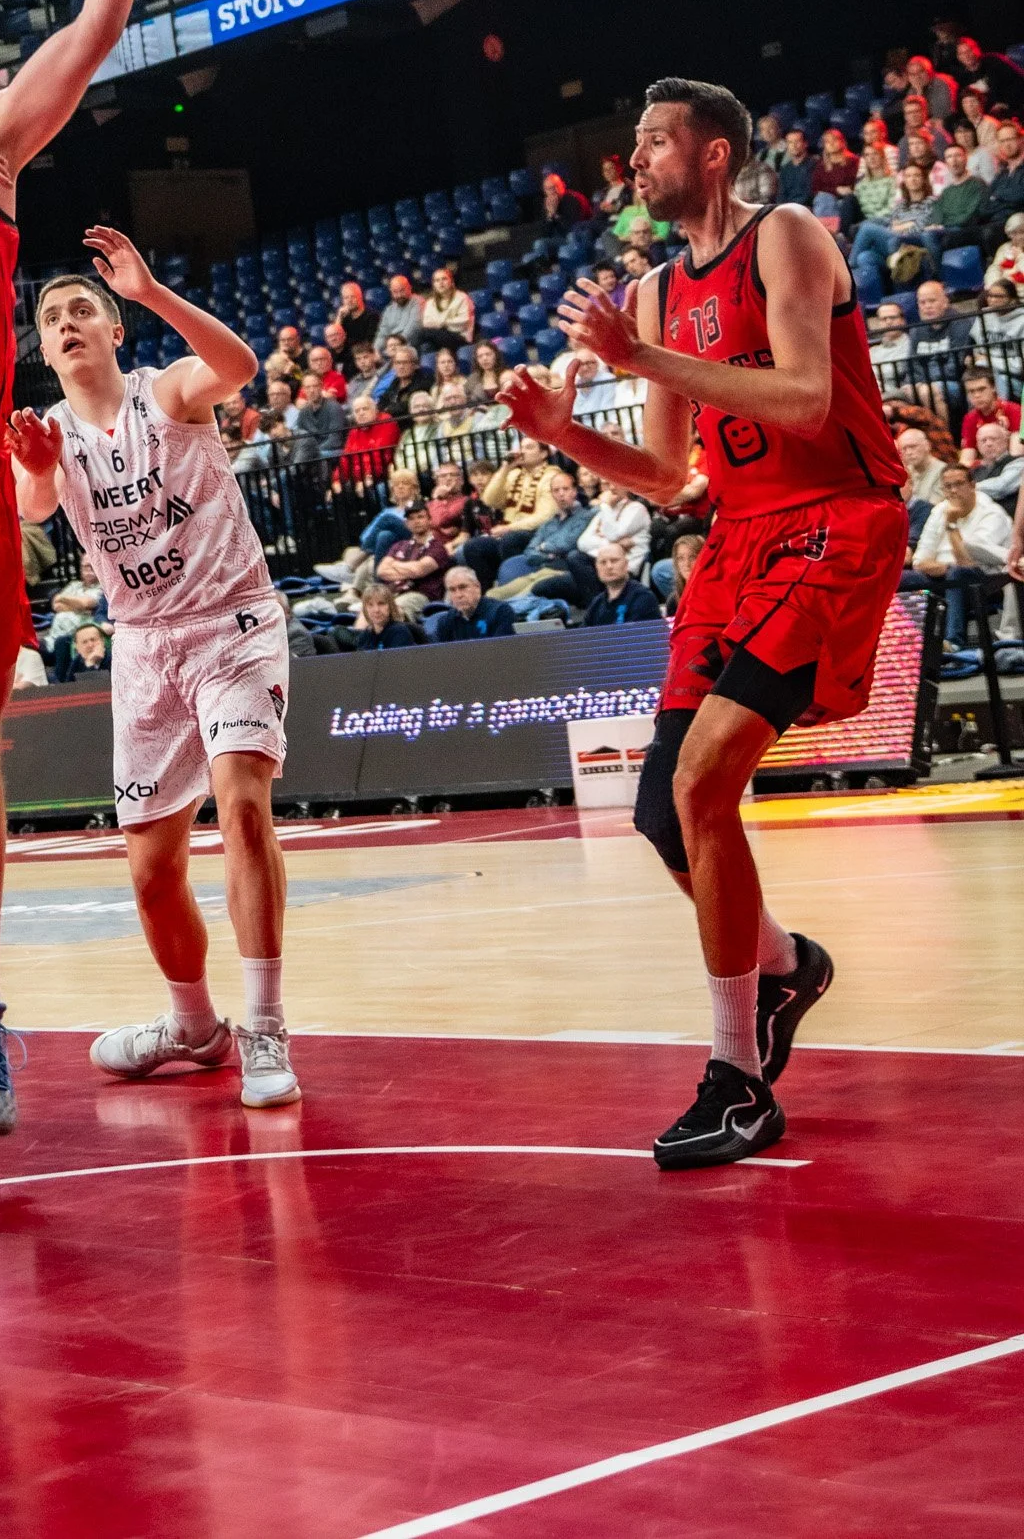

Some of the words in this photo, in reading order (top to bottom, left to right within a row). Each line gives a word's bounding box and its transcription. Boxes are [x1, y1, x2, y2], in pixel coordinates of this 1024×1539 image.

[689, 295, 723, 353] 13
[111, 449, 125, 473] 6
[118, 548, 185, 589] becs
[146, 573, 187, 599] SERVICES
[222, 719, 269, 730] fruitcake
[330, 703, 424, 741] Looking
[427, 698, 464, 731] for
[487, 686, 661, 736] gamechange
